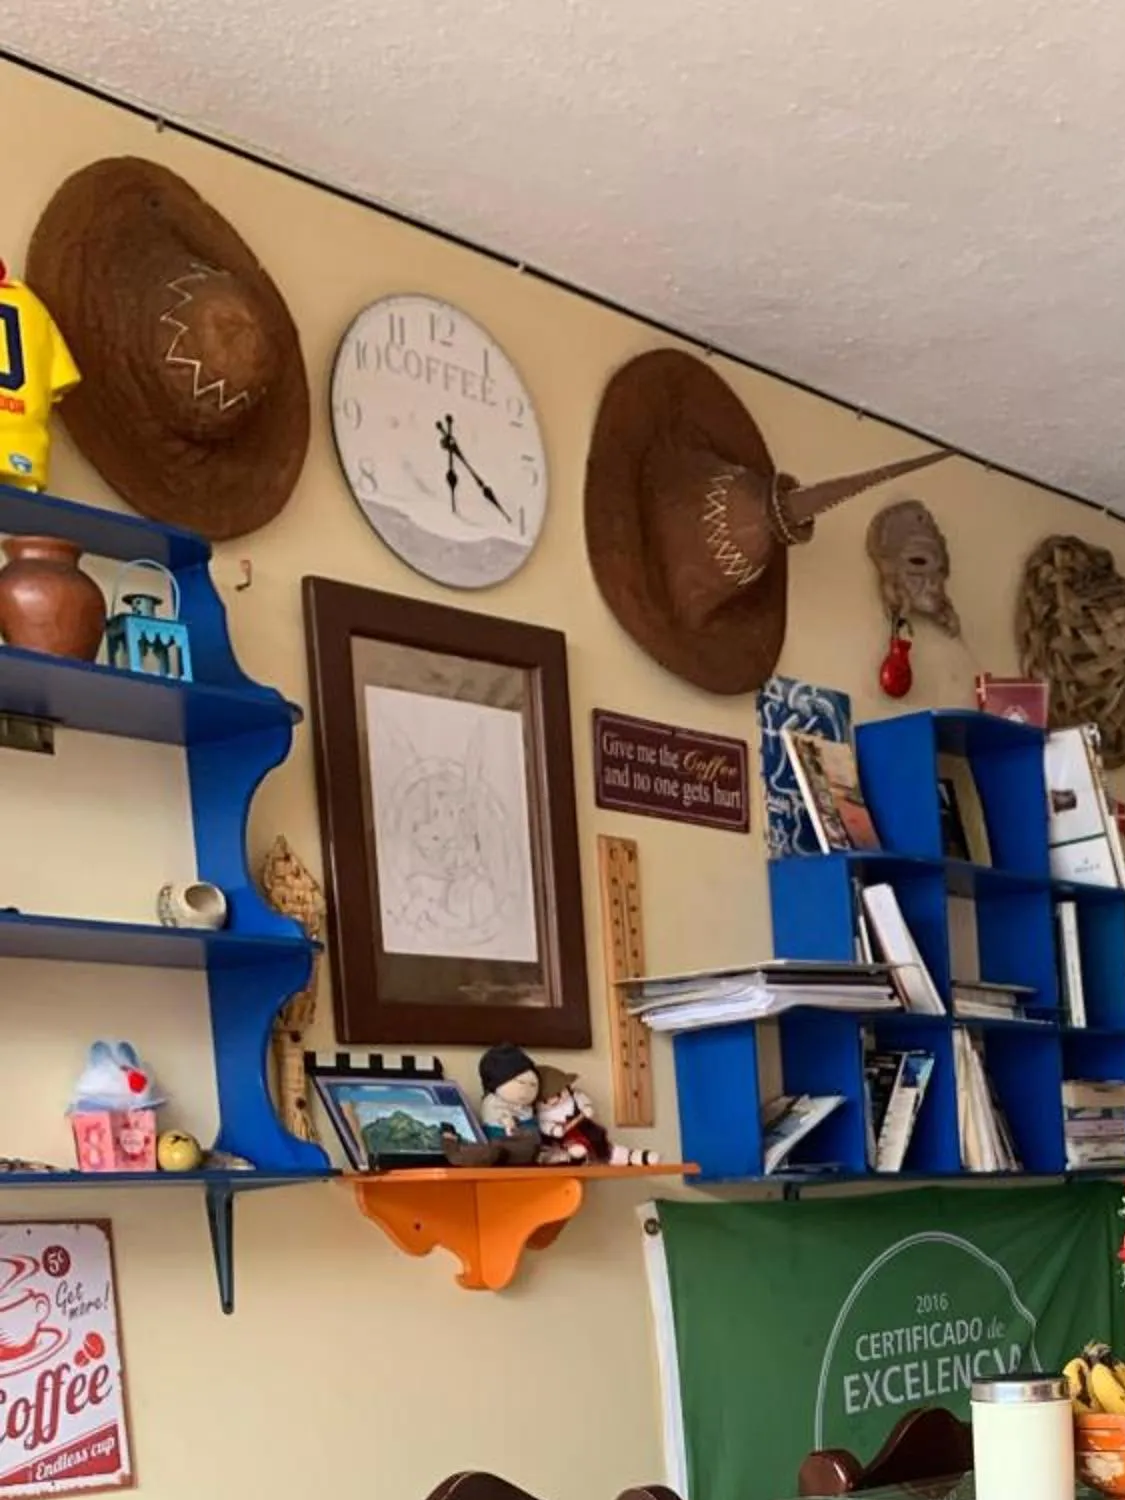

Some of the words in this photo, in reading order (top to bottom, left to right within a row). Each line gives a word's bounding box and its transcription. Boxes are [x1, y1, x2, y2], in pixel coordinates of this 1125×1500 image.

[388, 313, 406, 346] 11
[430, 312, 456, 347] 12
[384, 343, 498, 406] COFFEE
[342, 397, 363, 431] 9
[506, 396, 525, 428] 2
[357, 456, 379, 494] 8
[603, 731, 635, 760] Give
[636, 744, 657, 766] me
[659, 743, 679, 770] the
[683, 751, 738, 784] Coffee
[604, 762, 630, 788] and
[633, 772, 651, 793] no
[653, 776, 680, 798] one
[682, 782, 711, 807] gets
[713, 781, 741, 808] hurt
[55, 1280, 82, 1316] Get
[915, 1292, 950, 1315] 2016
[855, 1316, 984, 1362] CERTIFICADO
[986, 1314, 1006, 1341] de
[0, 1362, 113, 1451] offee
[35, 1447, 89, 1481] Endless
[90, 1436, 118, 1461] cup
